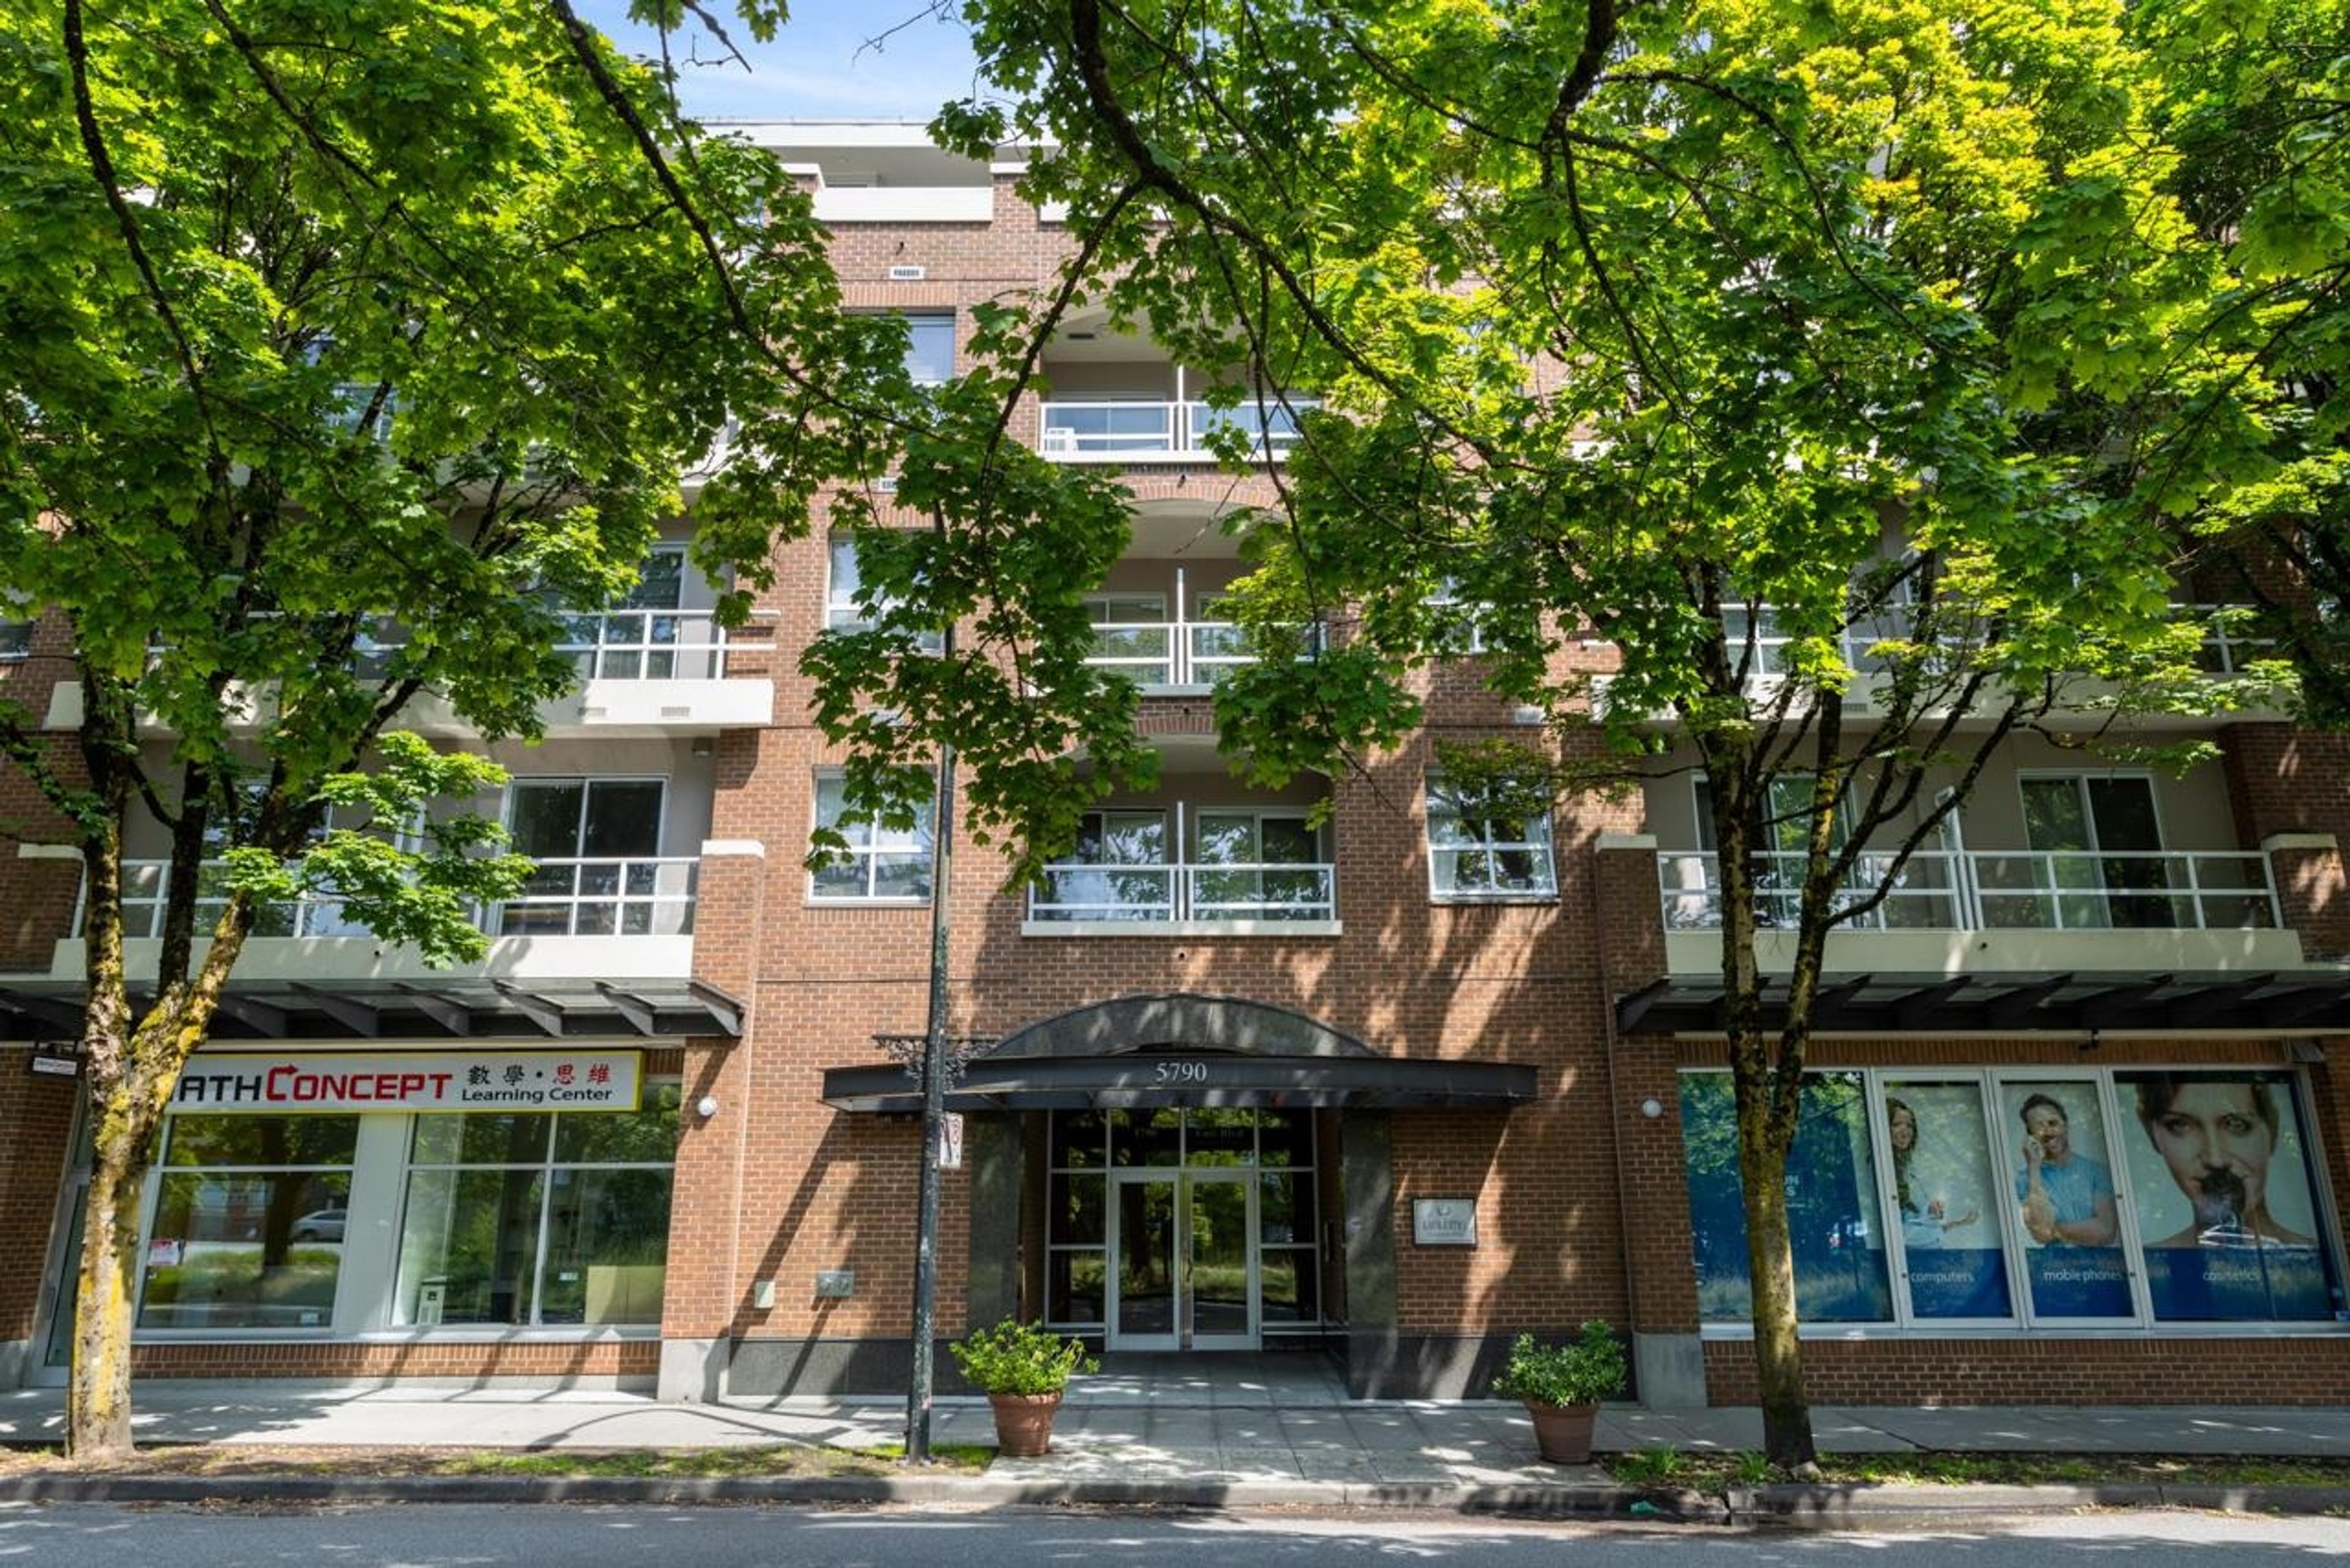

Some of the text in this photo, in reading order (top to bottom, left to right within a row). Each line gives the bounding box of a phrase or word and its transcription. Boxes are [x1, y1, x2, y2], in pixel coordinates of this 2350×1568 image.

[1155, 1062, 1207, 1082] 5790
[170, 1064, 453, 1101] ATHCONCEPT
[462, 1087, 613, 1104] Learning Center
[1911, 1272, 1974, 1285] computers
[2043, 1269, 2122, 1283] mobile phones
